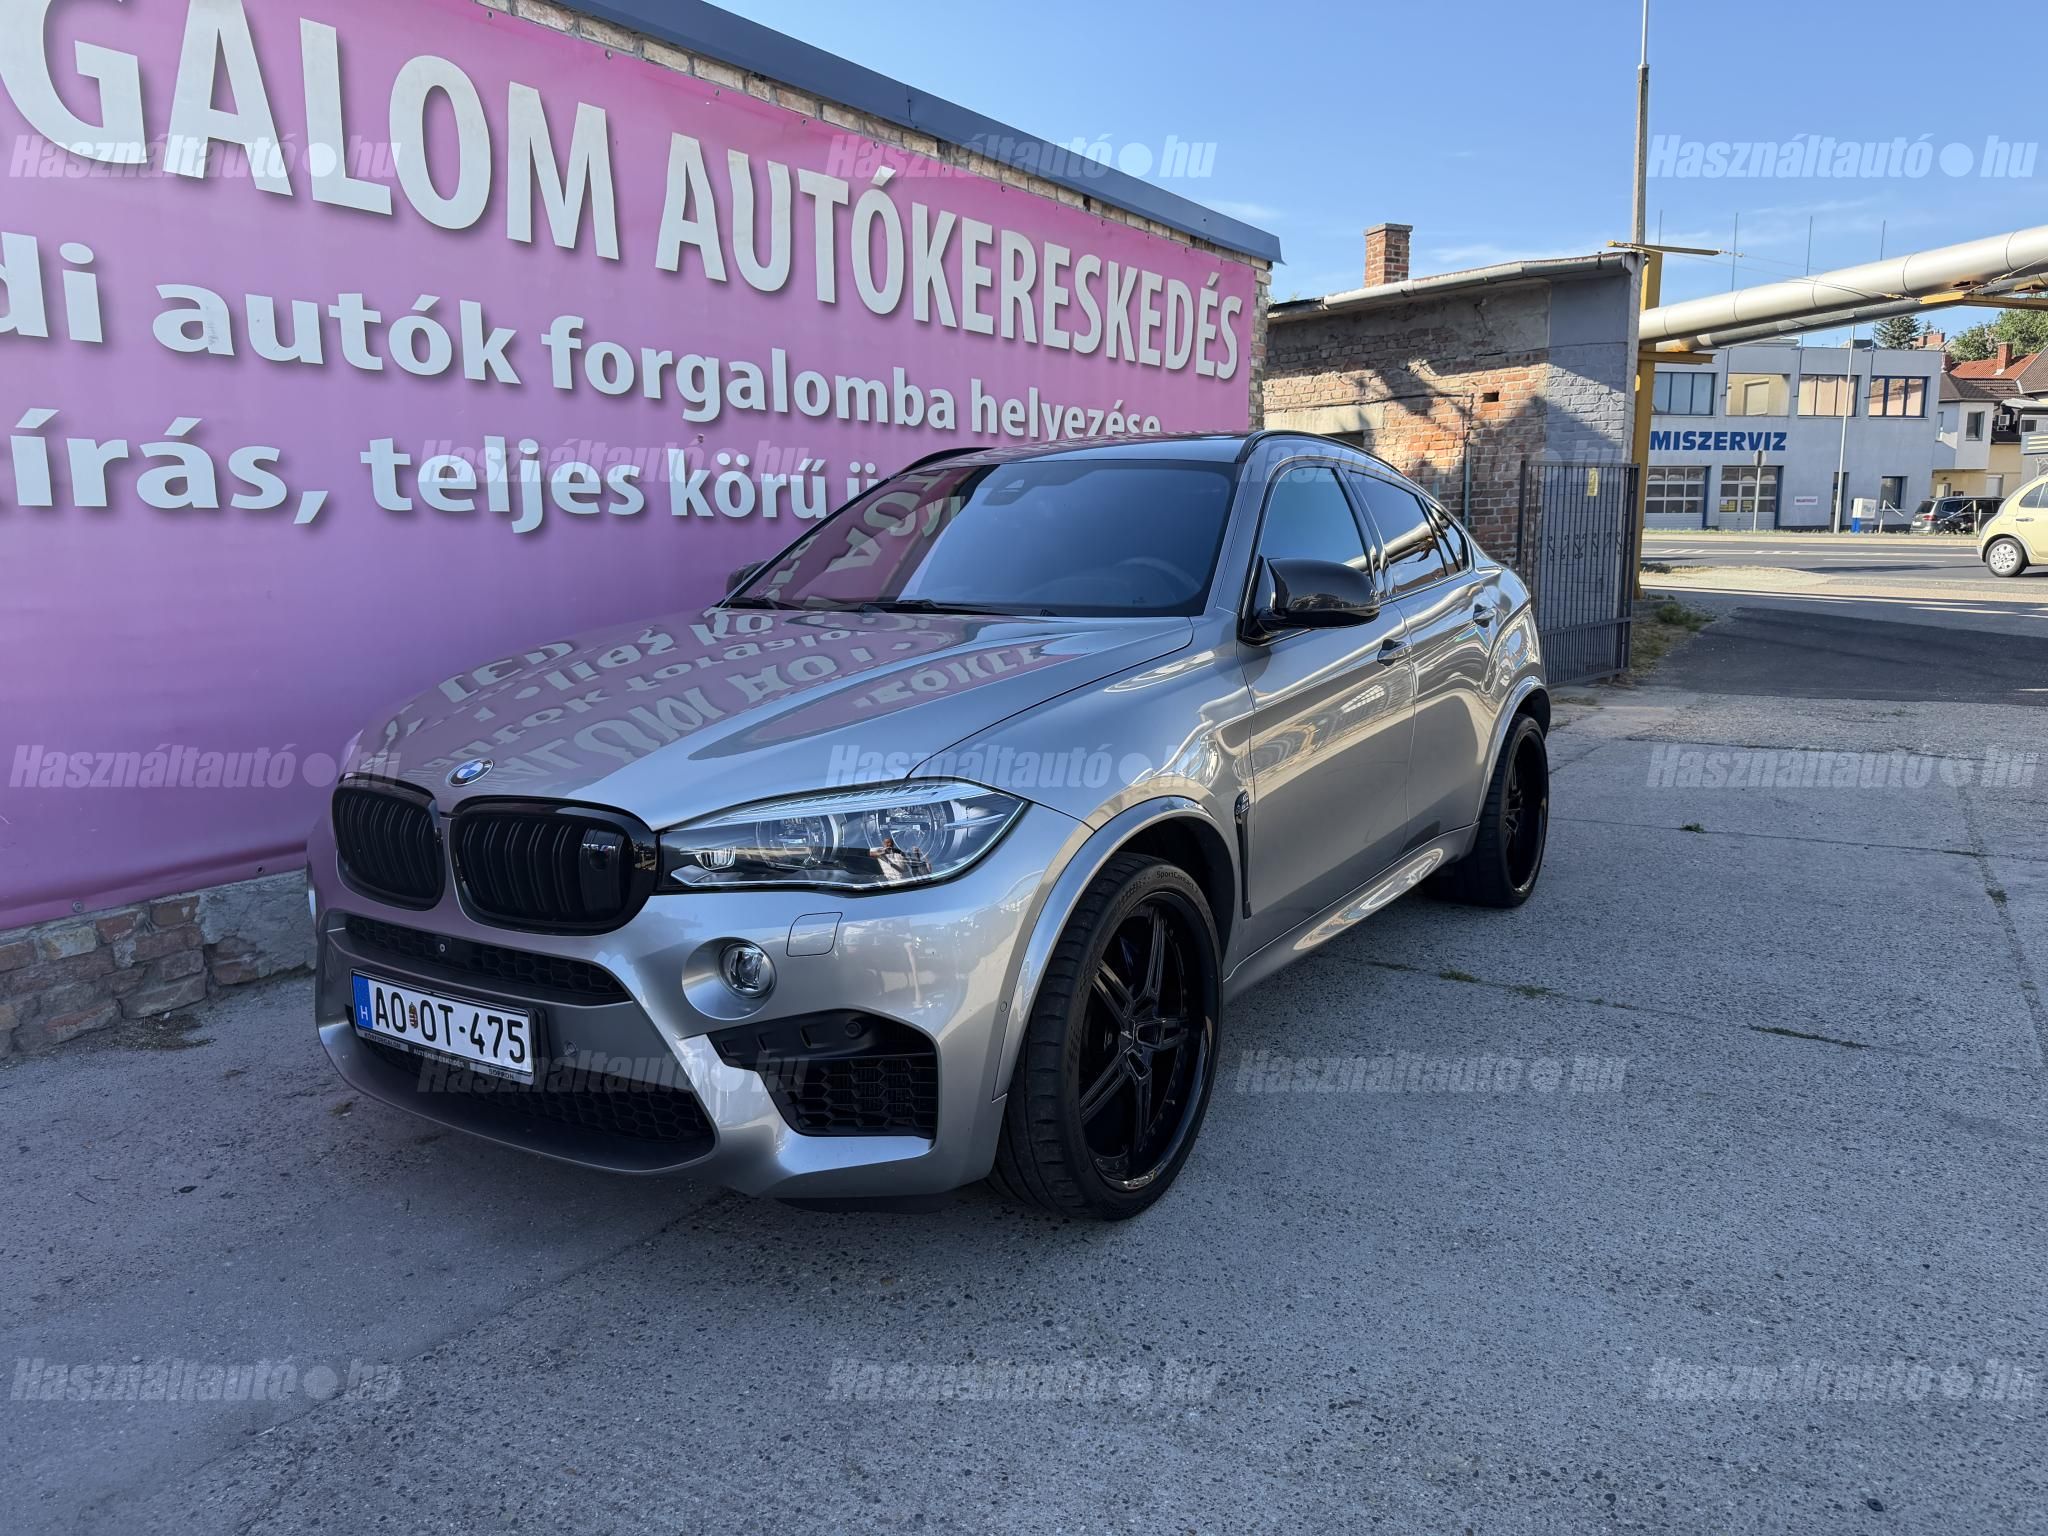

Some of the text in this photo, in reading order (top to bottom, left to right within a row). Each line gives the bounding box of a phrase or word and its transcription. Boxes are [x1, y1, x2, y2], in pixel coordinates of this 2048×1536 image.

[655, 131, 1243, 380] AUTÓKERESKEDÉS
[152, 284, 521, 384] autók
[541, 315, 956, 430] forgalomba
[360, 435, 644, 534] teljes
[668, 448, 828, 520] körű
[1650, 431, 1787, 451] MISZERVIZ
[360, 1005, 369, 1022] H
